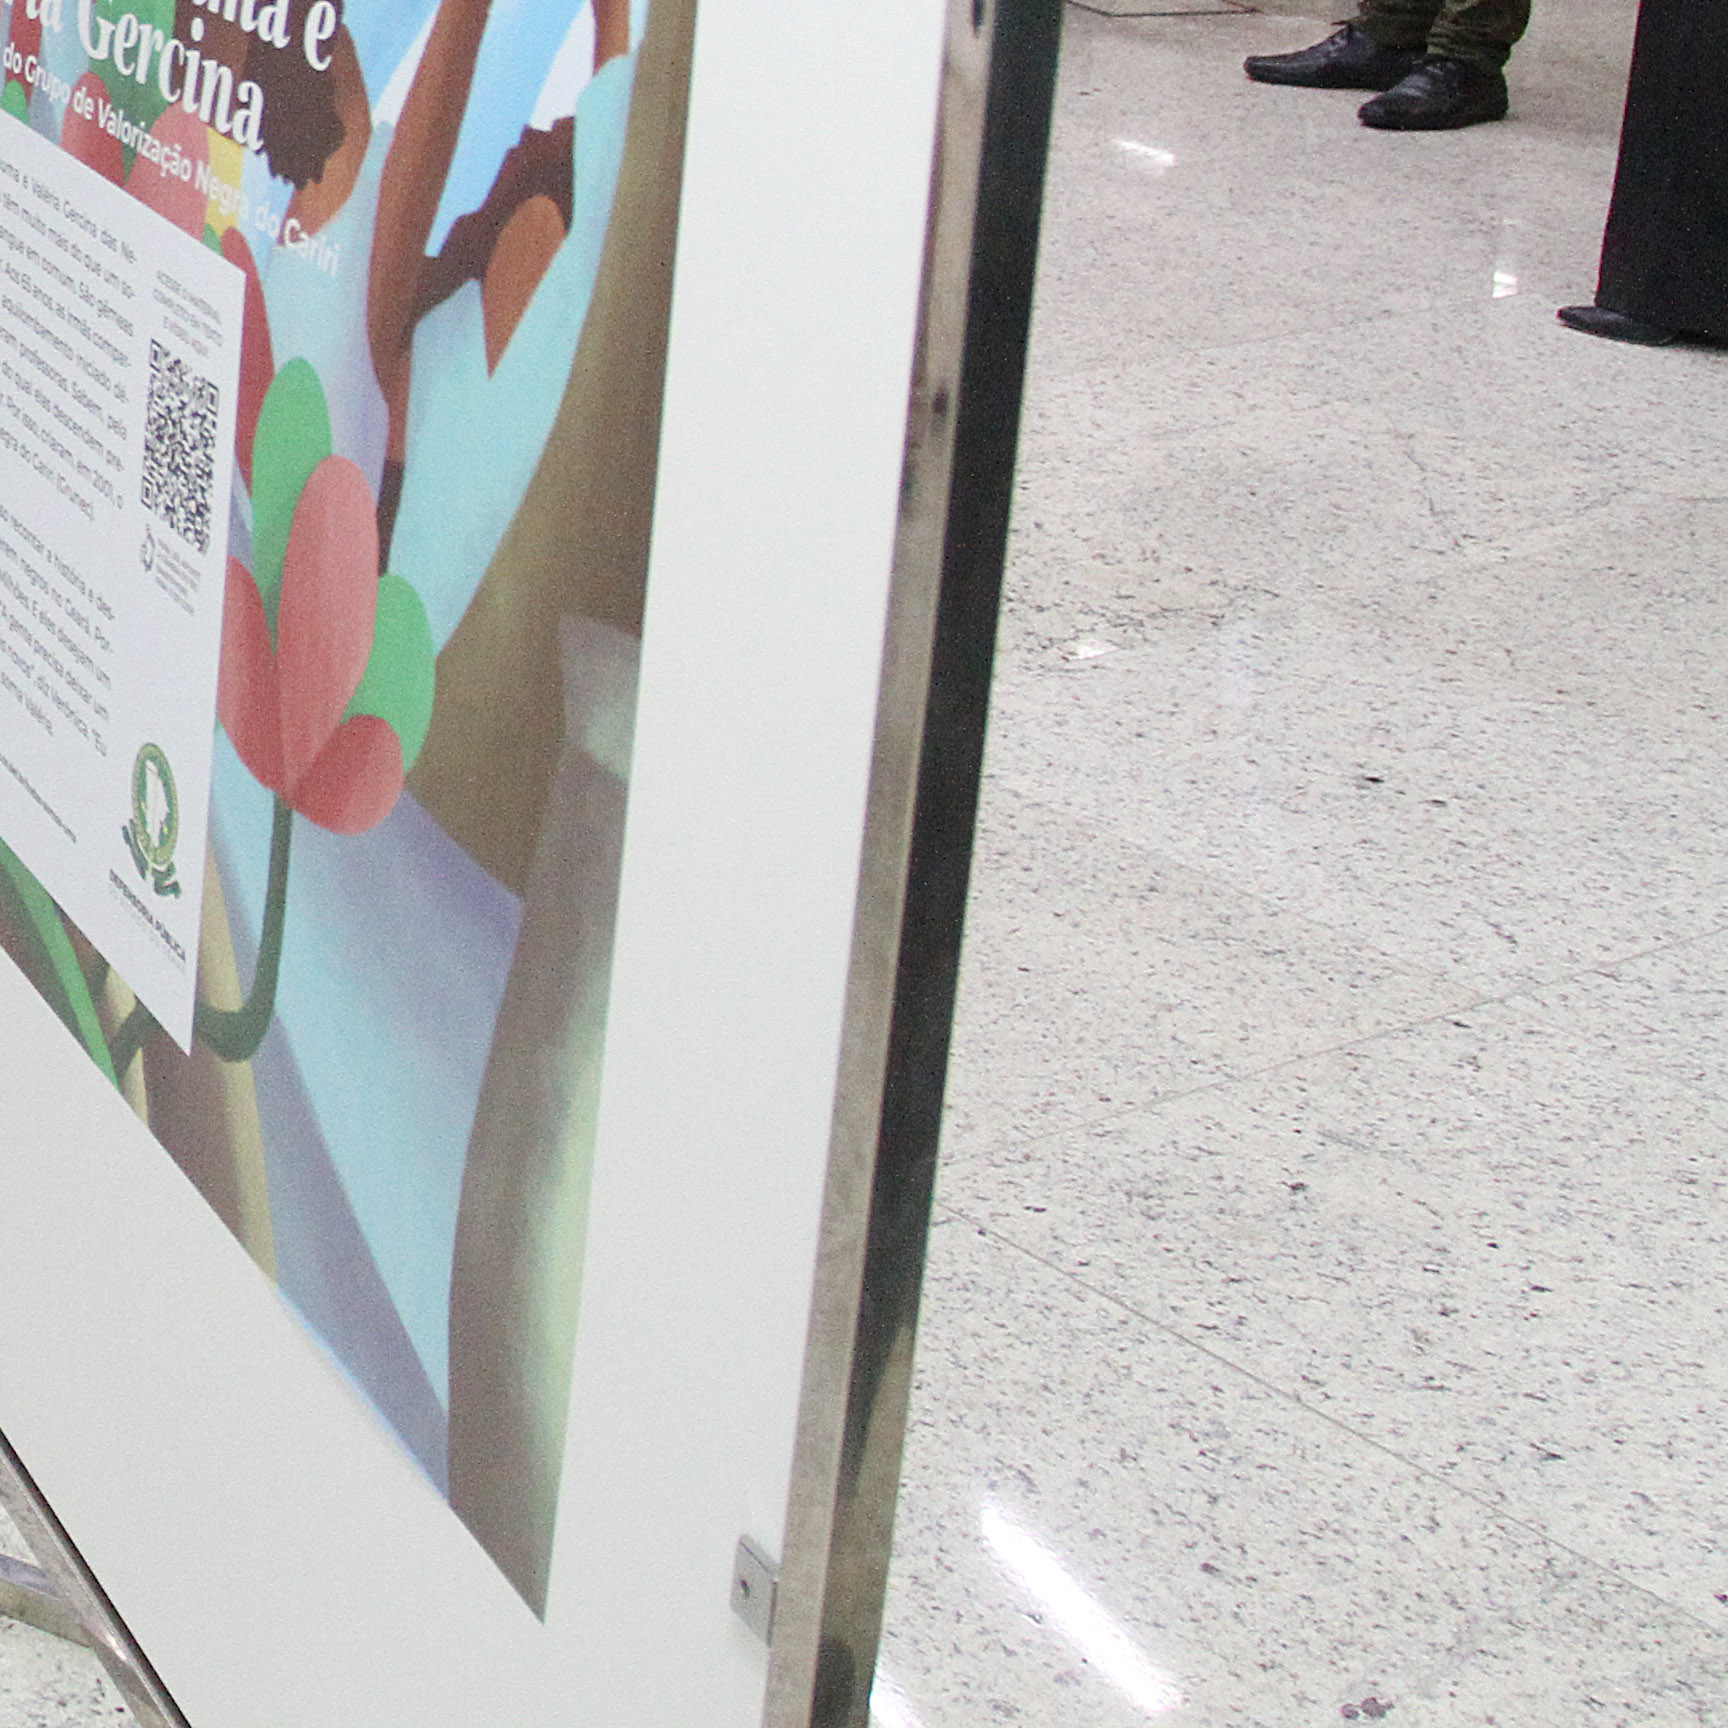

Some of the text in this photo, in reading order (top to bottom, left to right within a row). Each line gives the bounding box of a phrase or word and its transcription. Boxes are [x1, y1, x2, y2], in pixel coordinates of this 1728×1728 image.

[303, 0, 338, 71] e
[5, 42, 23, 75] do
[25, 56, 72, 112] Grupo
[73, 86, 96, 121] de
[98, 100, 192, 182] Valorização
